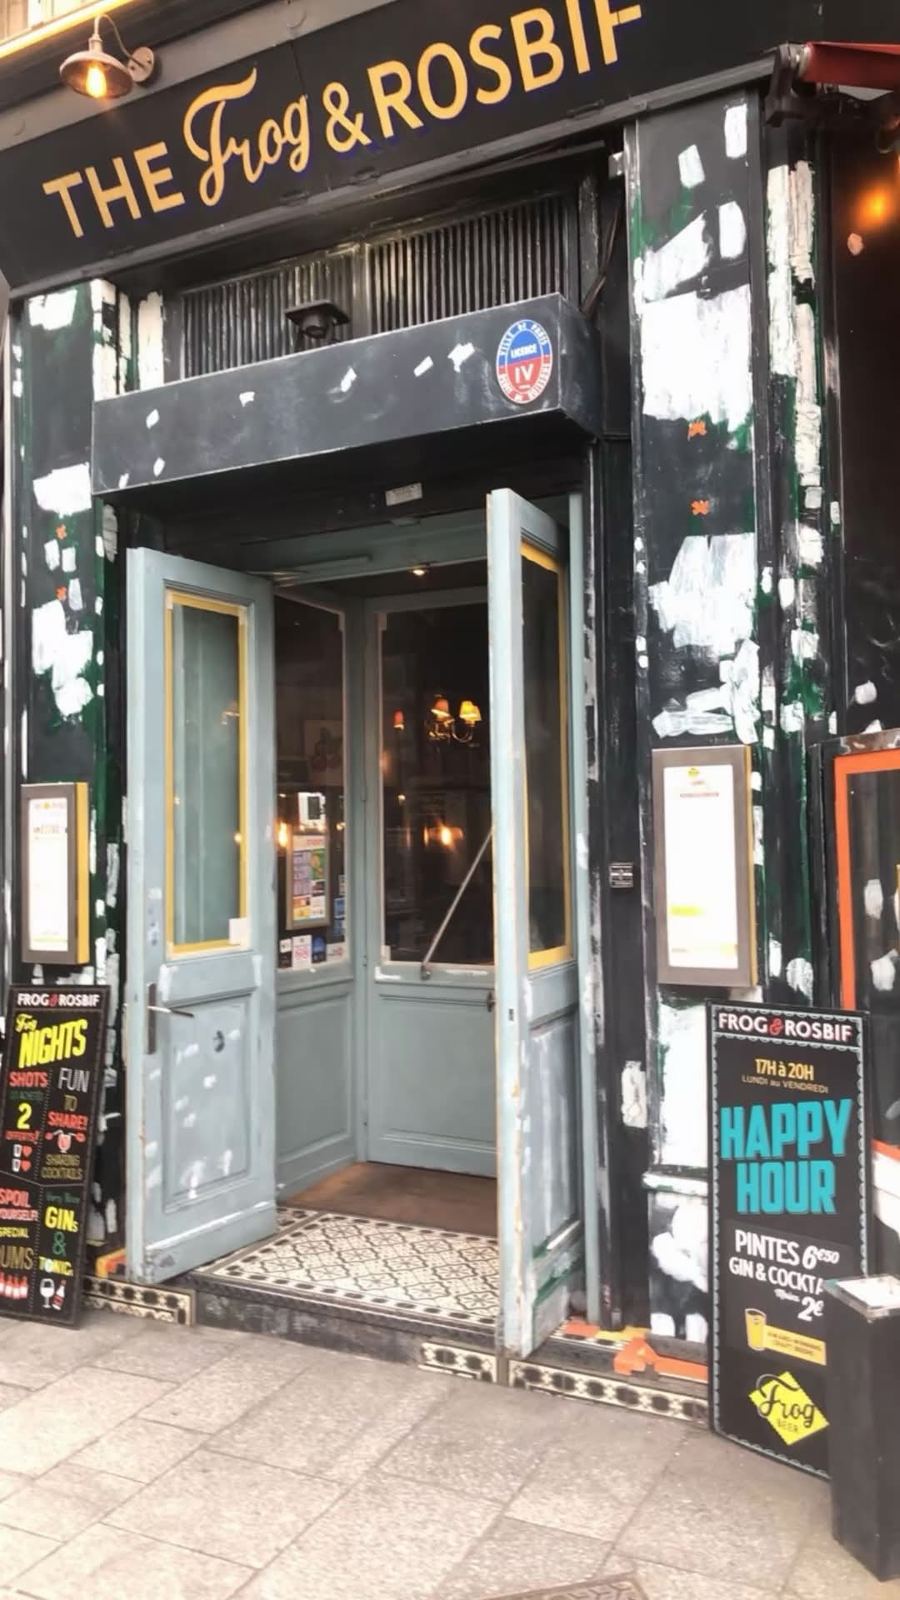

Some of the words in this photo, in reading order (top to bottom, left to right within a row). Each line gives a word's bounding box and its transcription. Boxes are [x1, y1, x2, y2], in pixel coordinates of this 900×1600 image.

[42, 141, 184, 239] THE
[183, 67, 311, 207] Frog
[325, 81, 370, 153] &
[367, 0, 642, 138] ROSBIF
[514, 363, 534, 384] IV
[17, 992, 49, 1007] FROG
[58, 993, 100, 1007] ROSBIF
[718, 1012, 768, 1034] FROG
[784, 1019, 853, 1042] ROSBIF
[18, 1018, 88, 1069] NIGHTS
[9, 1071, 49, 1088] SHOTS
[58, 1067, 90, 1093] FUN
[754, 1058, 777, 1076] 17H
[787, 1062, 815, 1081] 20H
[741, 1074, 769, 1086] LUNDI
[782, 1079, 829, 1094] VENDREDI
[17, 1102, 32, 1130] 2
[48, 1110, 89, 1130] SHARE!
[720, 1098, 853, 1160] HAPPY
[0, 1187, 31, 1208] SPOIL
[736, 1159, 837, 1216] HOUR
[0, 1208, 39, 1222] OURSELF!
[0, 1244, 34, 1270] UMS
[52, 1231, 67, 1257] &
[735, 1229, 800, 1266] PINTES
[728, 1256, 754, 1279] GIN
[755, 1262, 767, 1281] &
[768, 1265, 824, 1295] COCKTA
[755, 1373, 816, 1429] Frog
